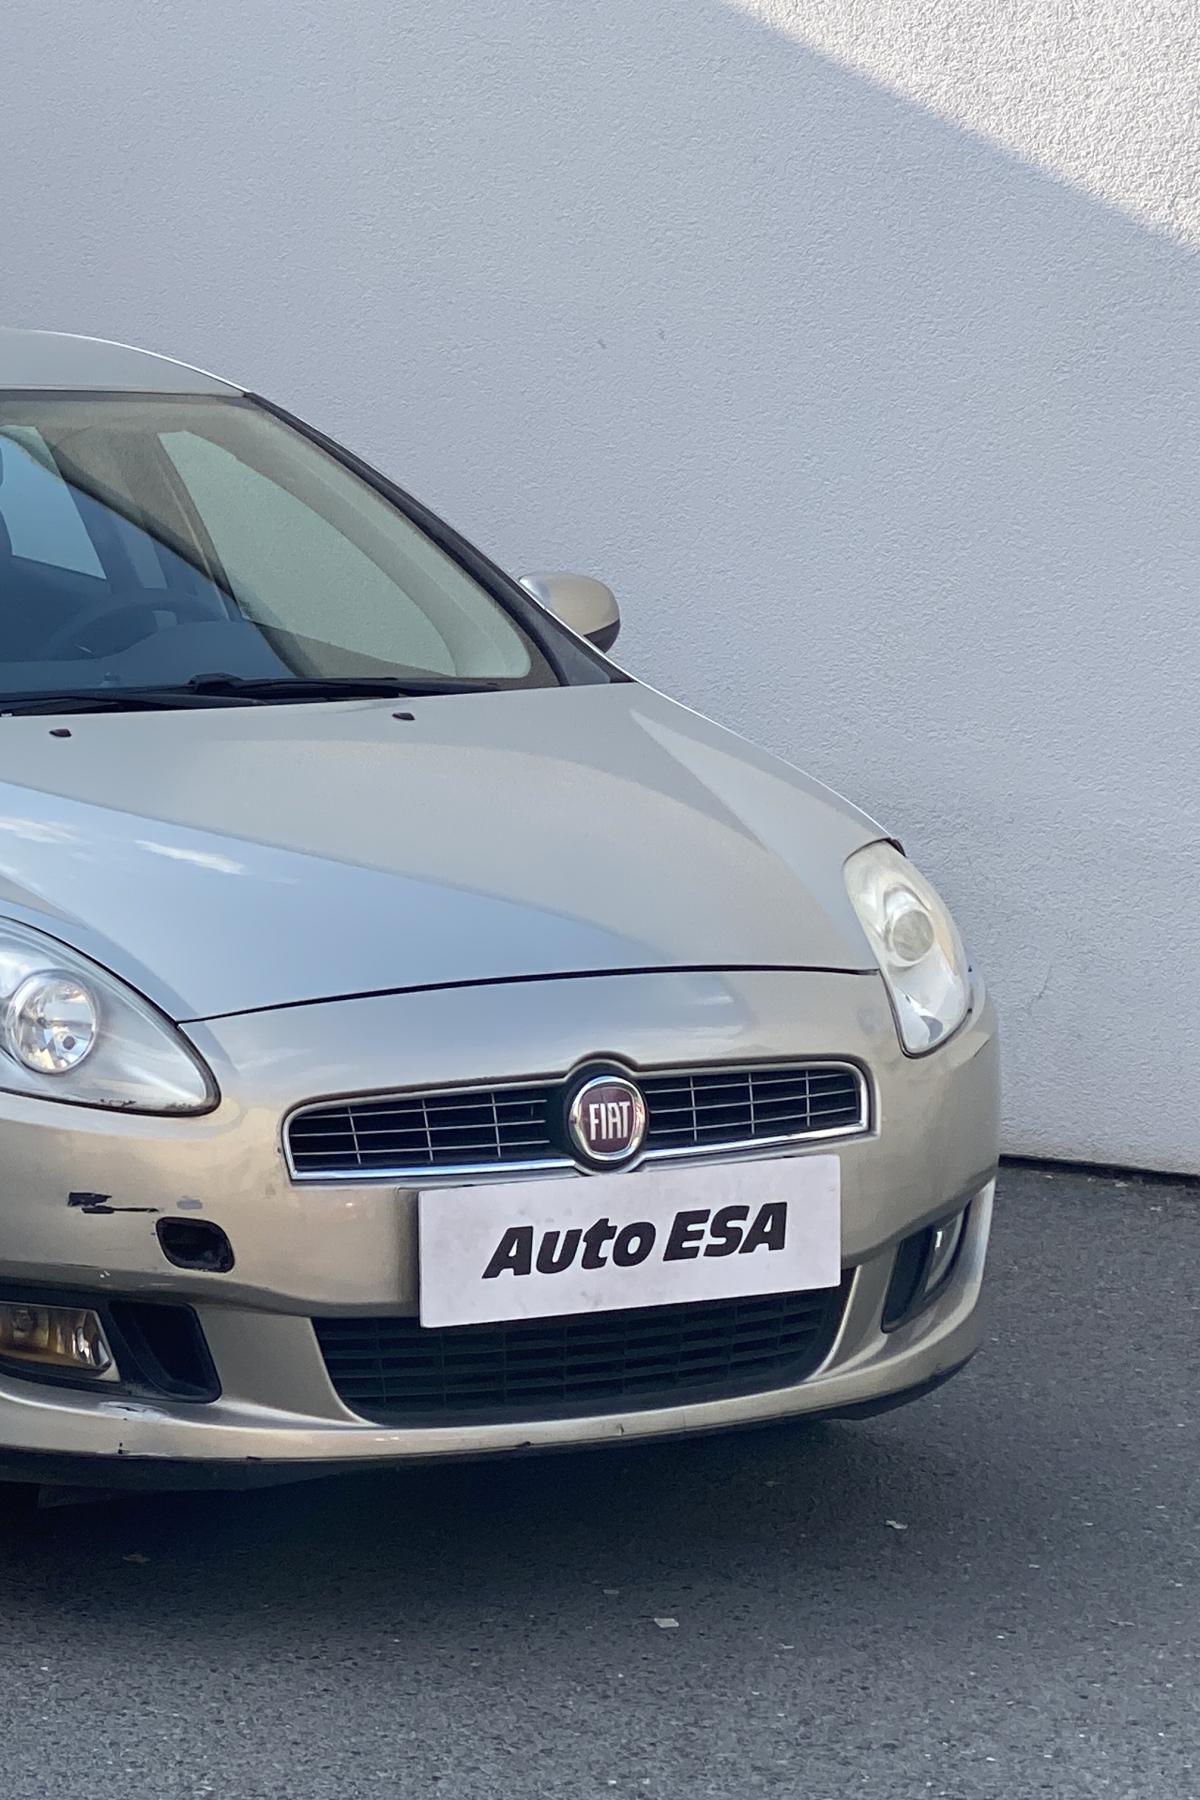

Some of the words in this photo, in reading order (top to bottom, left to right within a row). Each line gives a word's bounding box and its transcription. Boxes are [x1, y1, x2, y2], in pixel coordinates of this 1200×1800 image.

[588, 1100, 631, 1141] FIAT
[482, 1218, 656, 1279] Auto
[662, 1201, 788, 1261] ESA
